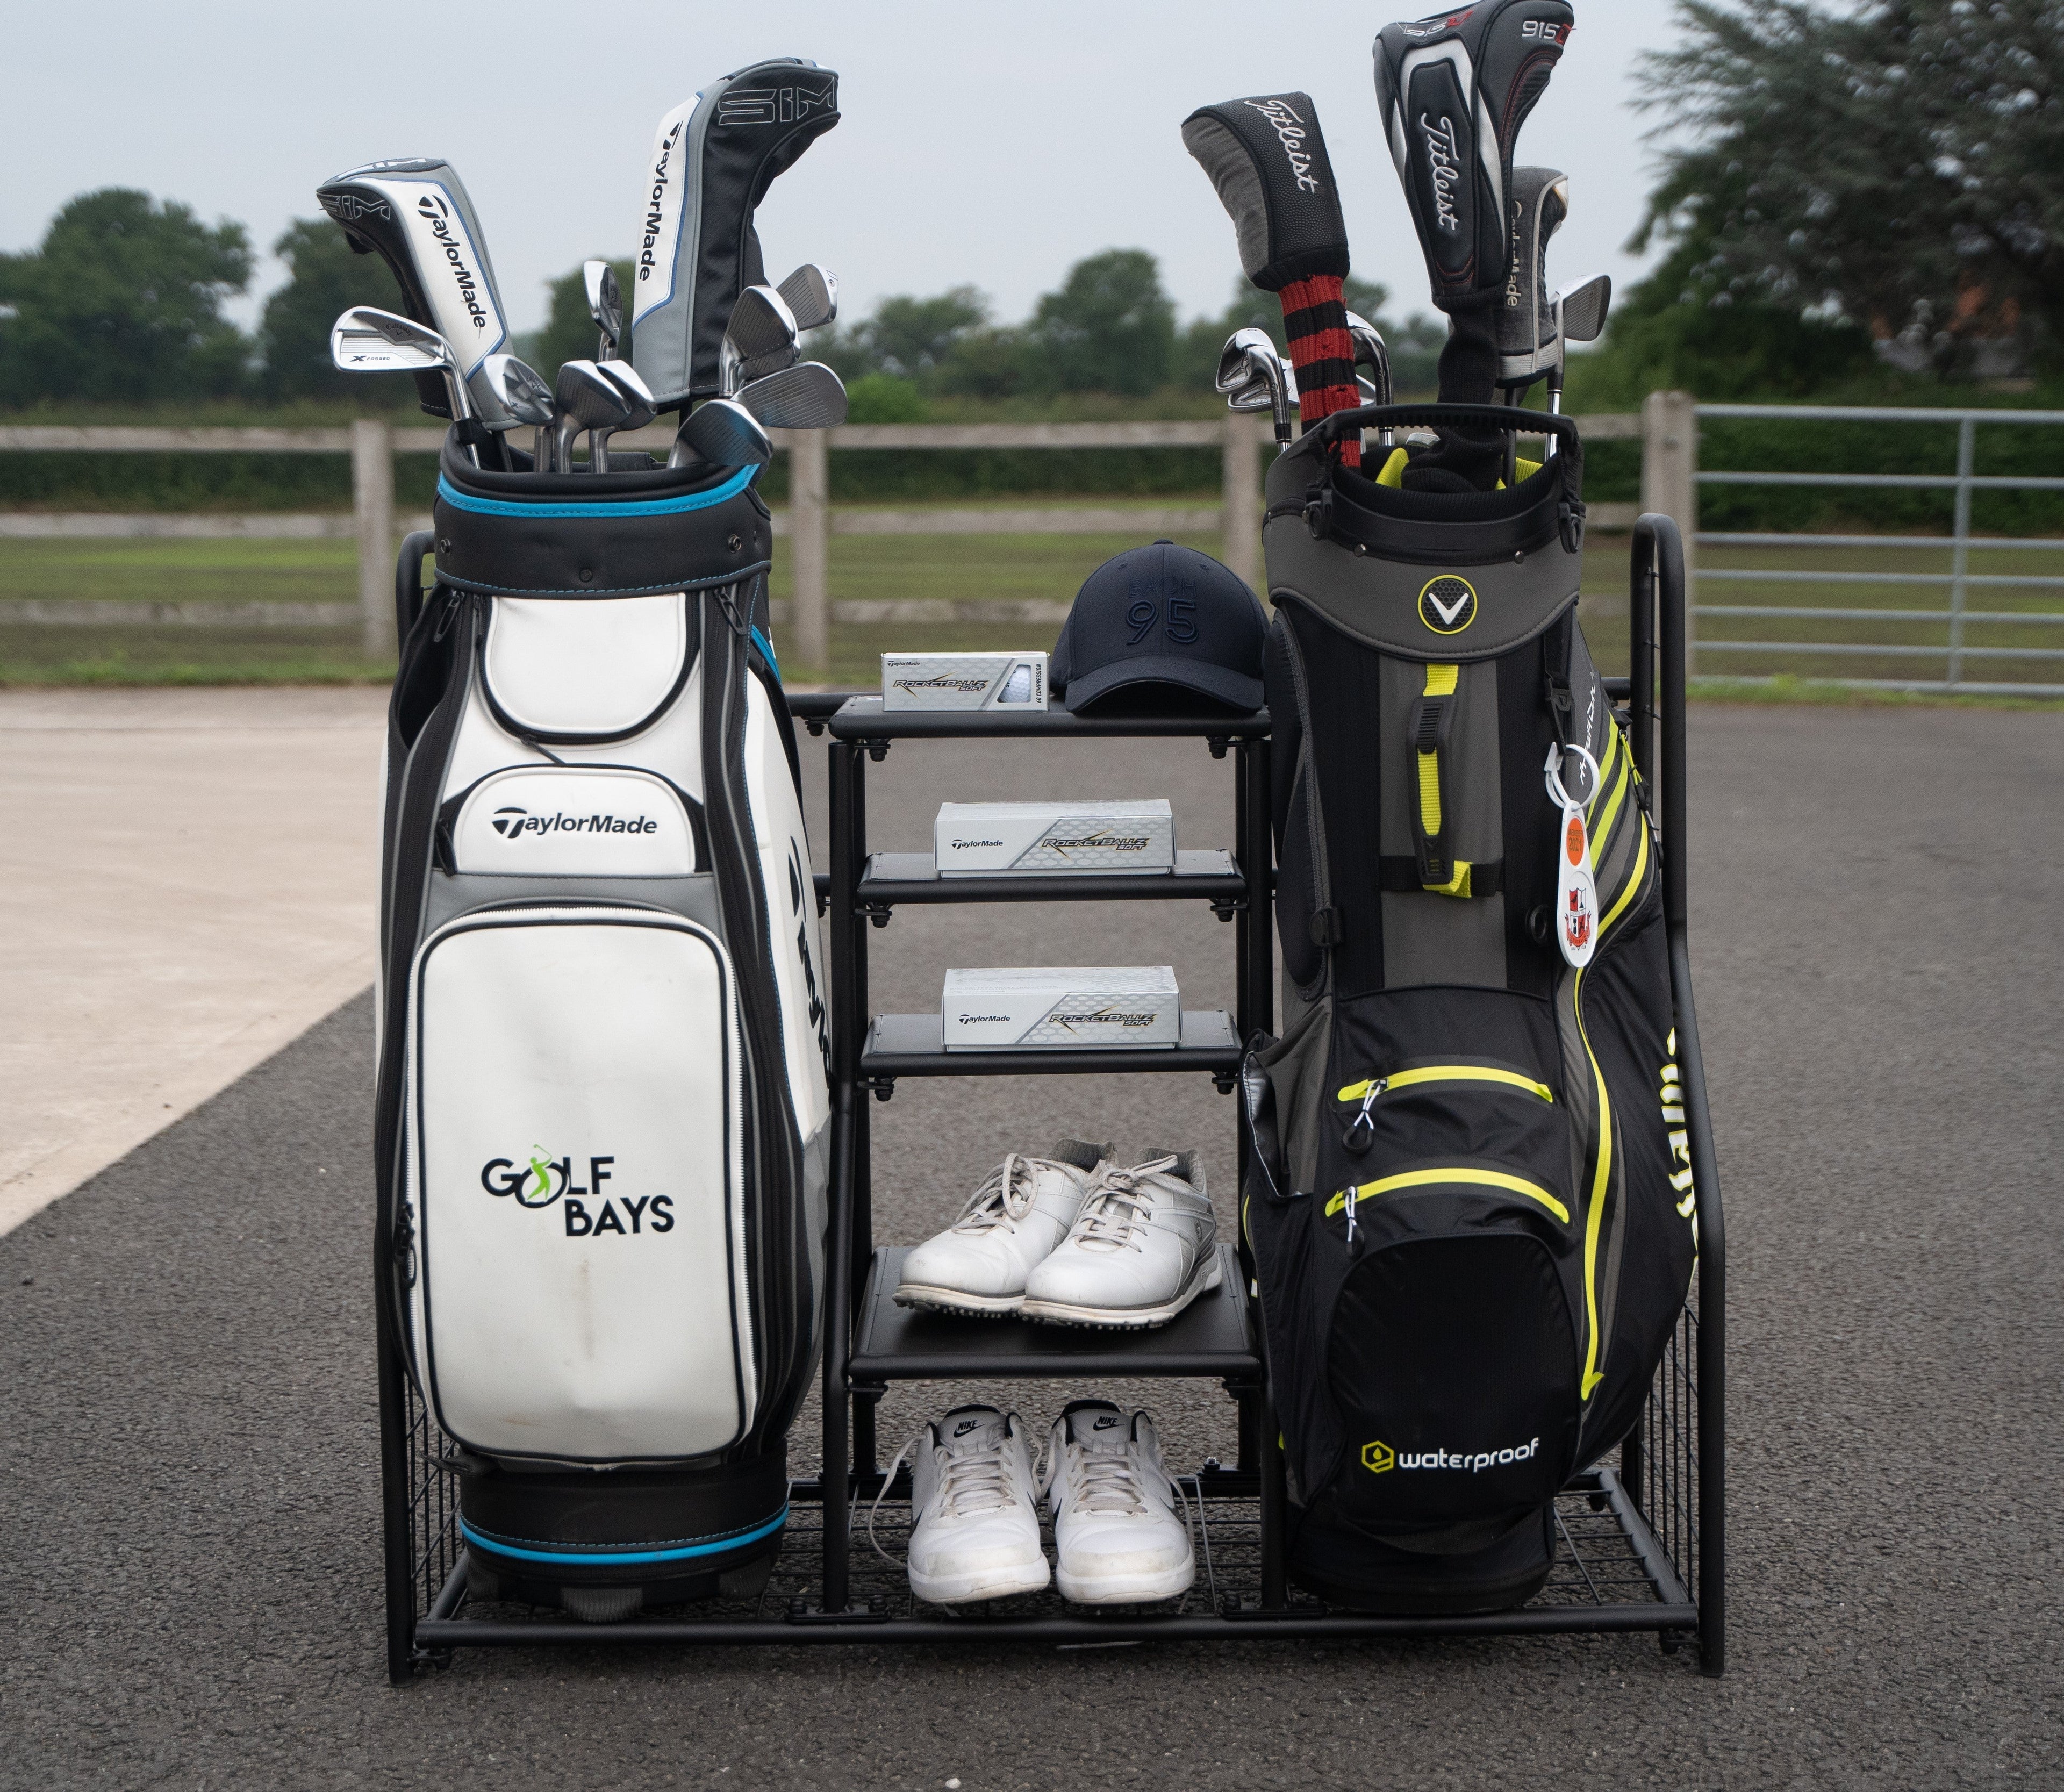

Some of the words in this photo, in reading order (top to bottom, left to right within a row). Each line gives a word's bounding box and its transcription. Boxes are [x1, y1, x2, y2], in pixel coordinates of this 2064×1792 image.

[718, 77, 835, 126] SIM
[1244, 99, 1318, 194] Titleist
[1420, 112, 1460, 231] Titleist
[639, 119, 684, 282] TaylorMade
[418, 195, 486, 329] TaylorMade
[385, 323, 413, 336] Callaway
[1126, 598, 1200, 646] 95
[491, 807, 657, 840] TaylorMade
[951, 839, 1003, 850] TaylorMade
[1568, 837, 1582, 852] 2021
[959, 1014, 1010, 1024] TaylorMade
[481, 1156, 614, 1209] GOLF
[564, 1195, 675, 1236] BAYS
[957, 1420, 978, 1431] NIKE
[1098, 1416, 1118, 1427] NIKE
[1399, 1437, 1539, 1472] waterproof
